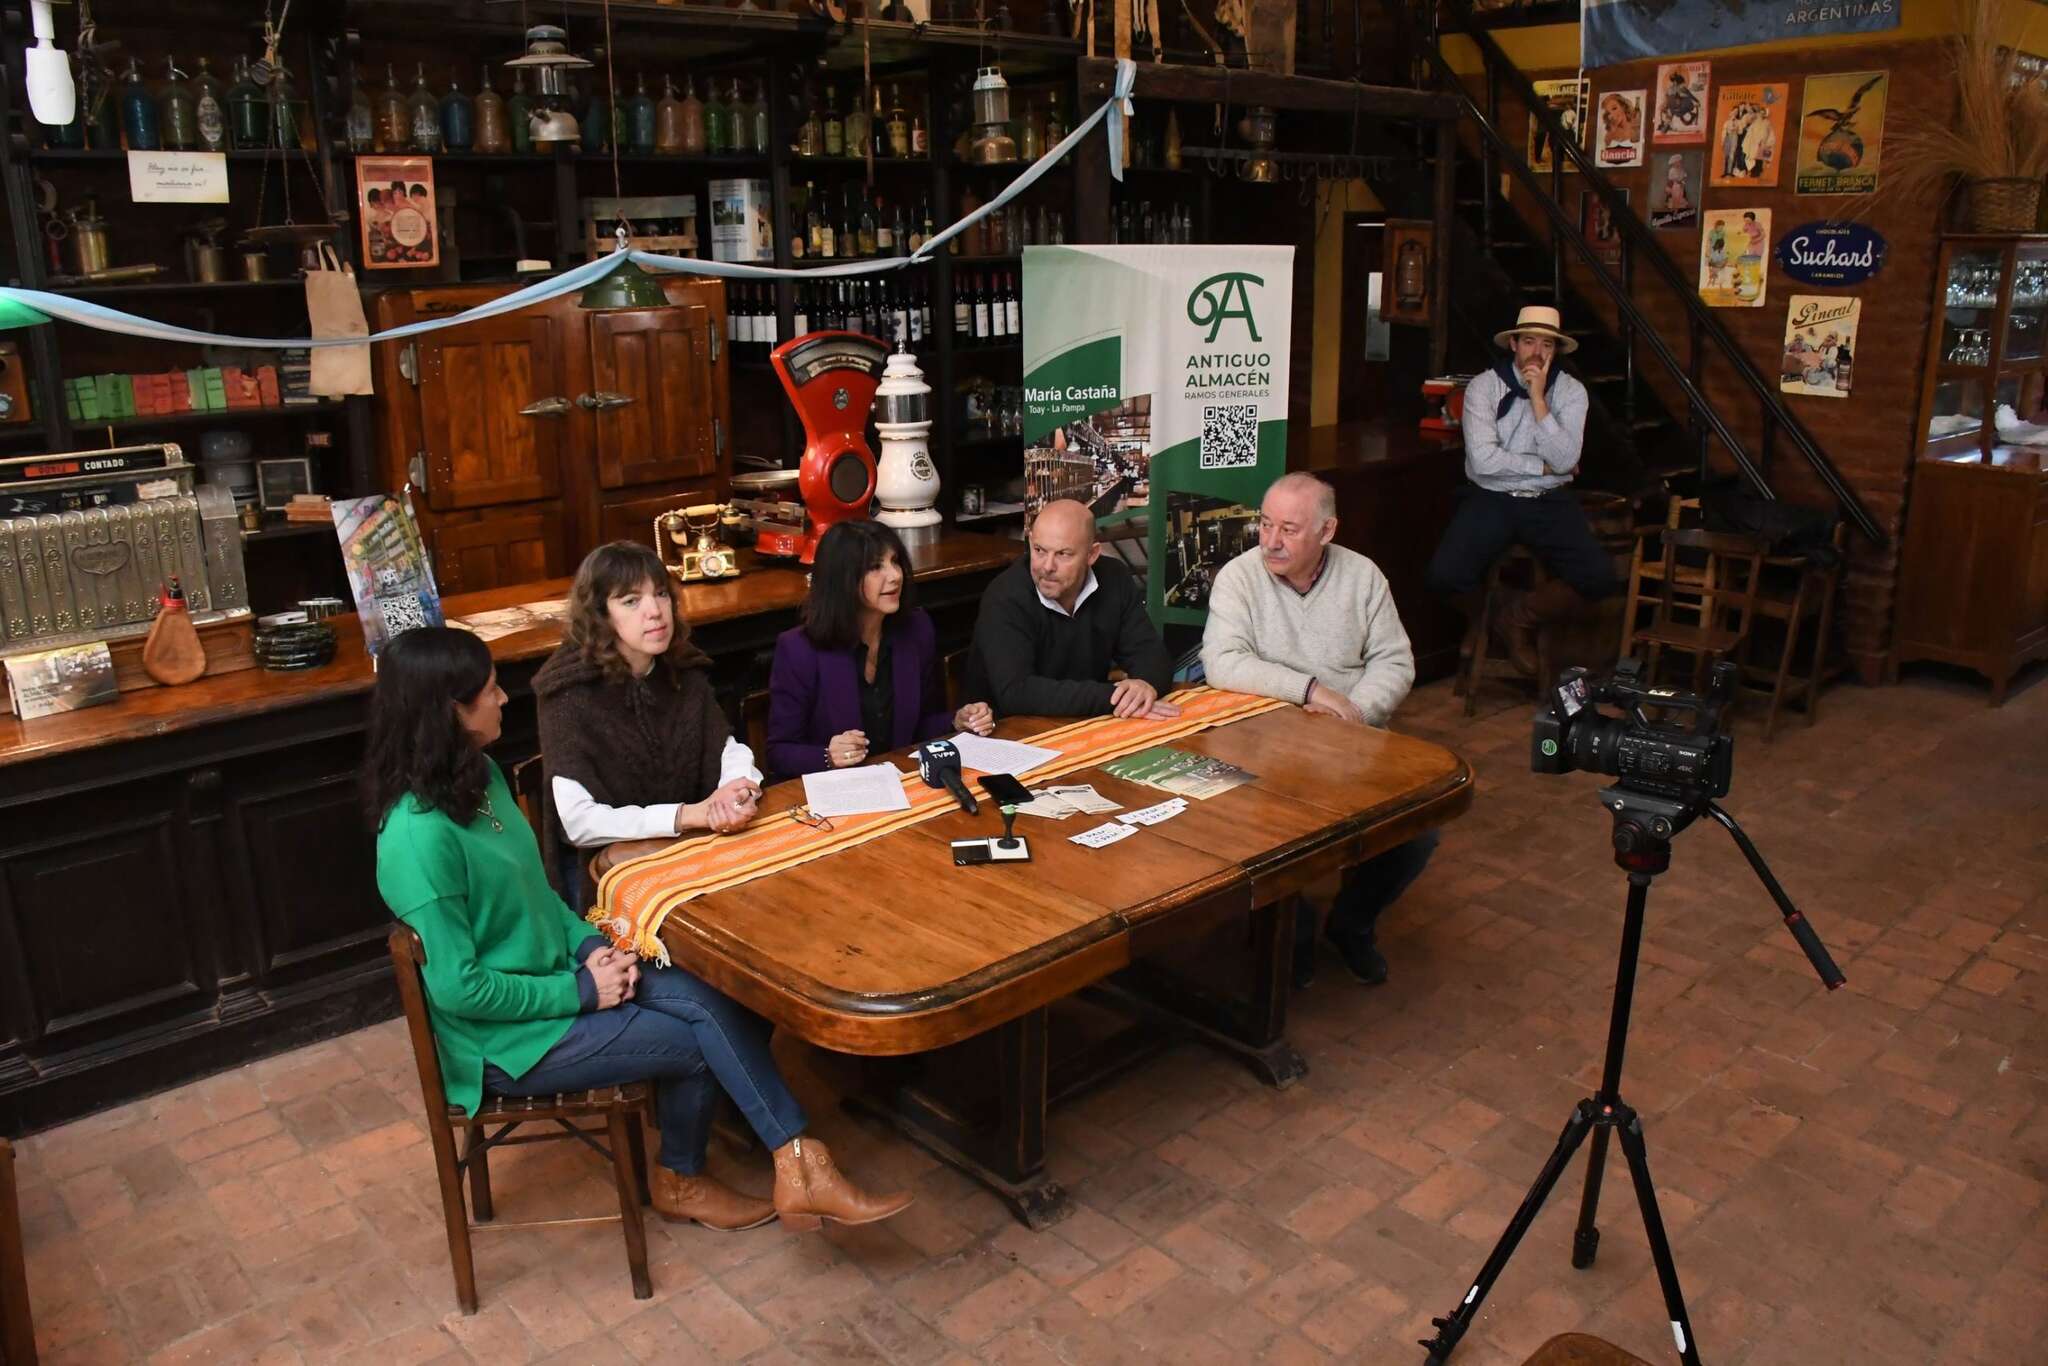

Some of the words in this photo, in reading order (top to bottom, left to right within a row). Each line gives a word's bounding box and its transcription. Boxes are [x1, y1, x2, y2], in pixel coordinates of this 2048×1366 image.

[1785, 0, 1893, 24] ARGENTINAS
[1601, 149, 1637, 160] Gancia
[1799, 178, 1831, 189] FERNET
[1836, 176, 1874, 187] BRANCA
[1790, 236, 1874, 267] Suchard
[1186, 353, 1271, 369] ANTIGUO
[1185, 369, 1270, 388] ALMACÉN
[1024, 386, 1062, 402] María
[1066, 385, 1117, 400] Castaña
[1184, 391, 1217, 400] RAMOS
[1218, 389, 1270, 399] GENERALES
[1029, 405, 1045, 416] Toay
[1052, 404, 1060, 413] La
[1062, 403, 1086, 415] Pampa
[84, 459, 124, 470] CONTADO
[931, 751, 956, 759] TVPP
[1678, 750, 1697, 758] SONY
